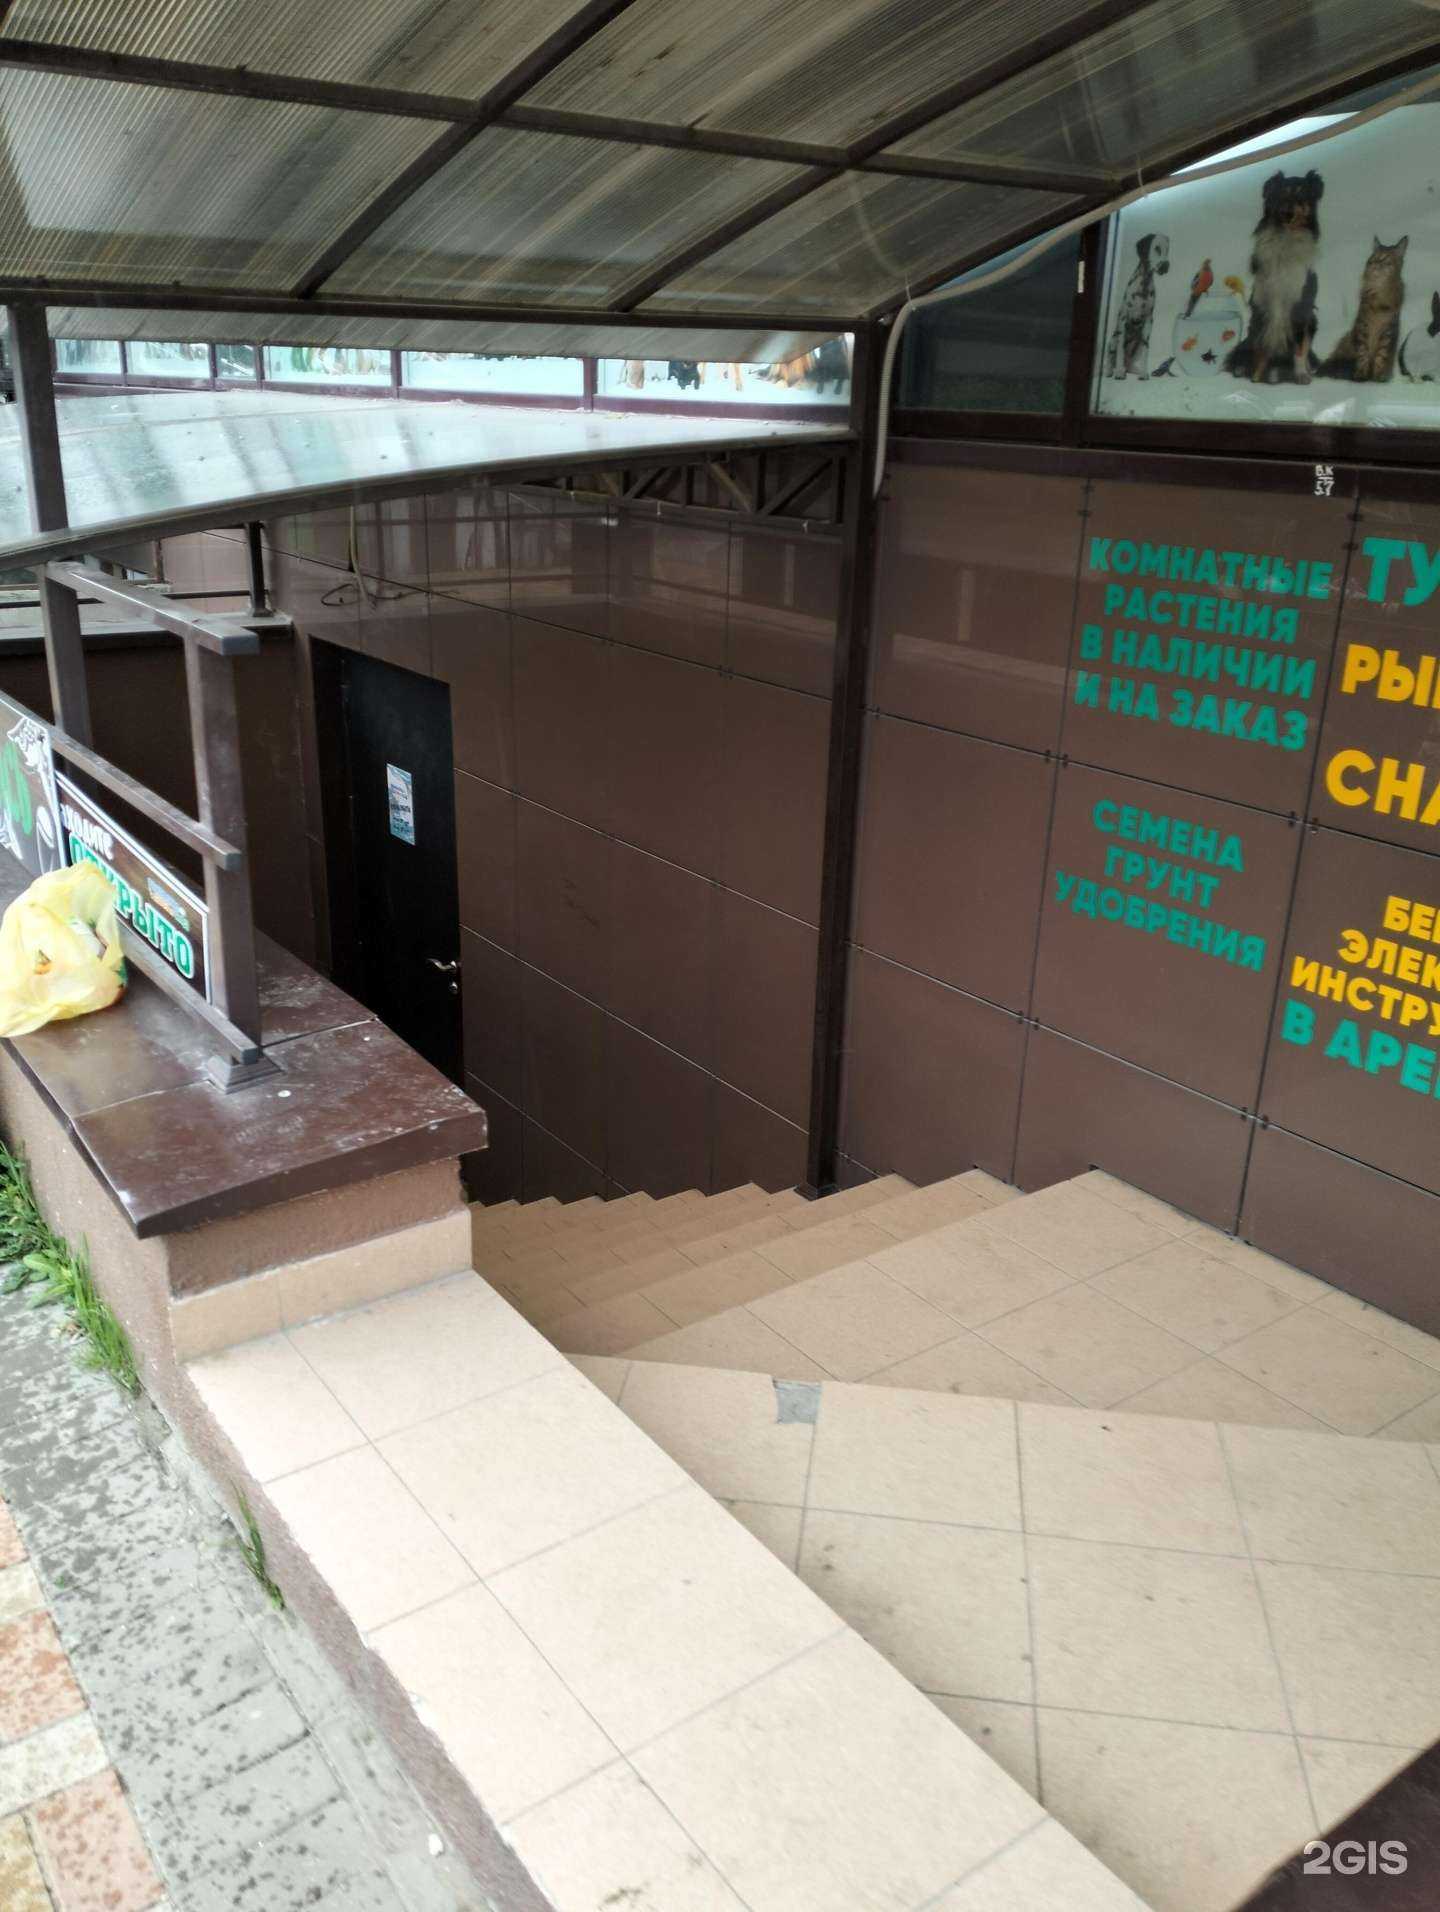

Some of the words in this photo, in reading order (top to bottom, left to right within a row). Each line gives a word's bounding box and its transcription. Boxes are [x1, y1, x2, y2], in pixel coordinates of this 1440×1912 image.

[1089, 537, 1333, 601] КОМНАТНЫЕ
[1362, 536, 1440, 607] ТУ
[1103, 583, 1301, 645] РАСТЕНИЯ
[1079, 623, 1104, 661] В
[1111, 628, 1318, 701] НАЛИЧИИ
[1340, 643, 1440, 711] РЫ
[1074, 669, 1101, 708] И
[1107, 676, 1160, 722] НА
[1168, 687, 1308, 752] ЗАКАЗ
[1092, 798, 1245, 873] СЕМЕНА
[1103, 844, 1221, 910] ГРУНТ
[1054, 870, 1267, 973] УДОБРЕНИЯ
[1383, 895, 1440, 945] БЕ
[1280, 998, 1317, 1047] В
[1324, 1018, 1440, 1101] АРЕ
